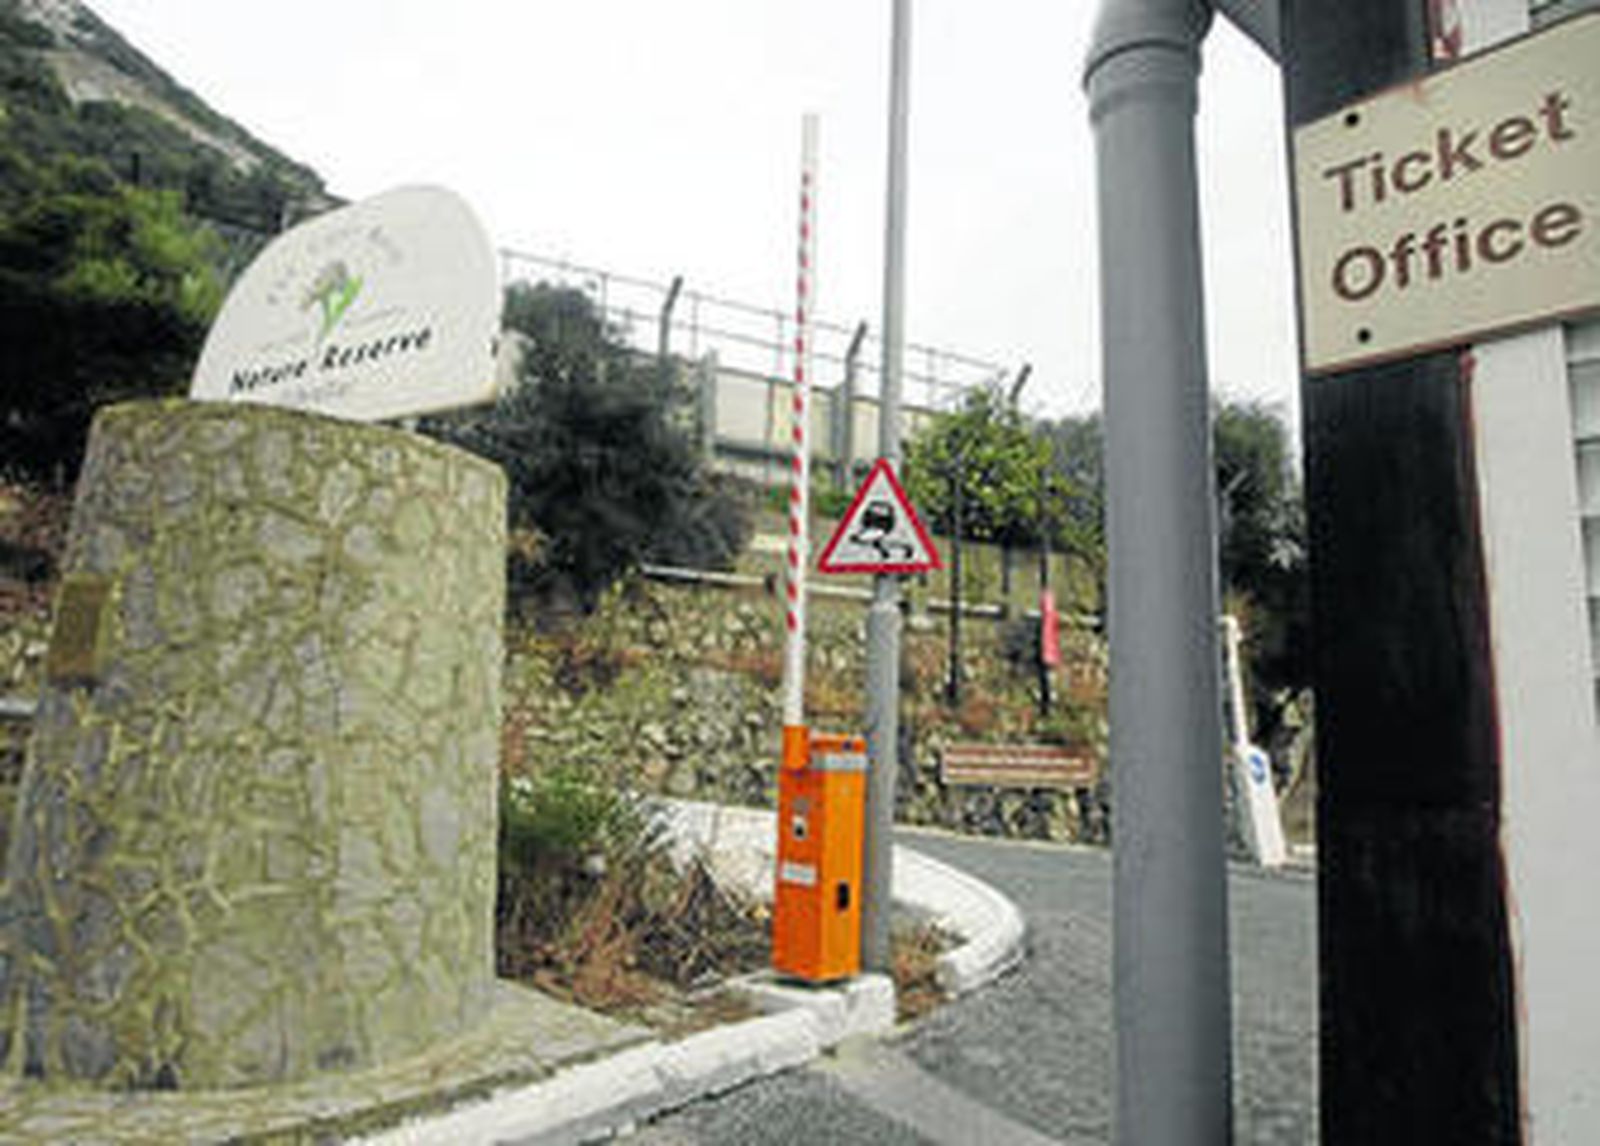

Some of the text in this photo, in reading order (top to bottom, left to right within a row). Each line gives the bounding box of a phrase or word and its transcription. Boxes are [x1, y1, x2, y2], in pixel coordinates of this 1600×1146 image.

[1323, 91, 1575, 211] Ticket
[1332, 203, 1583, 301] Office
[231, 361, 307, 391] Nature
[322, 326, 431, 370] Reserve
